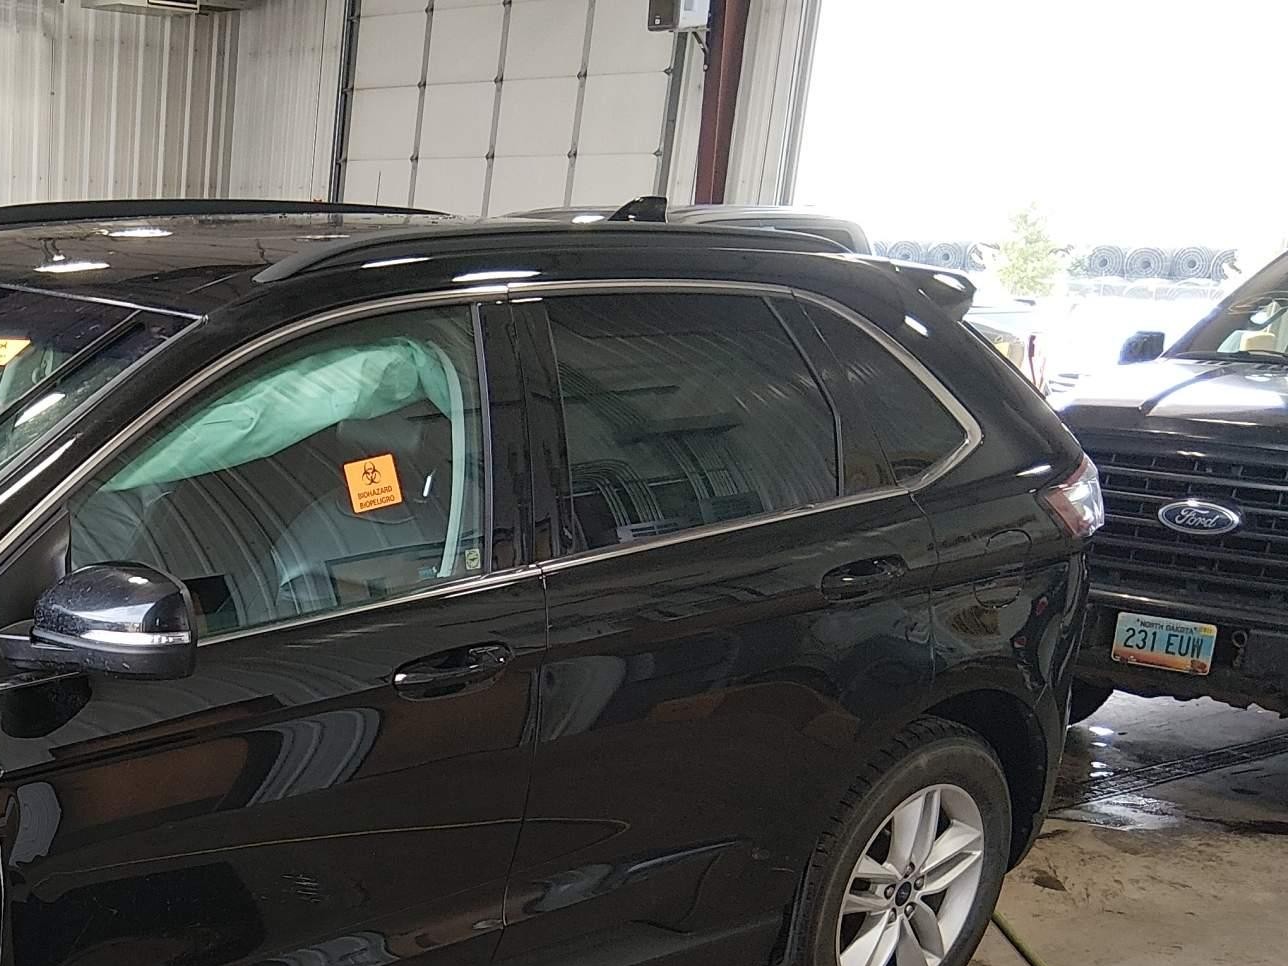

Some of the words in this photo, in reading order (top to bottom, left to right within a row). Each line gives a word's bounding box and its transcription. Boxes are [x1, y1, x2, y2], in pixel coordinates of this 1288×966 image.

[357, 485, 393, 500] BIOHAZARD
[359, 494, 395, 510] BIOPELIGRO
[1175, 507, 1220, 528] Ford
[1139, 621, 1164, 630] NORTH
[1165, 624, 1194, 634] DAKOTA
[1123, 627, 1157, 652] 231
[1165, 633, 1204, 659] EUW
